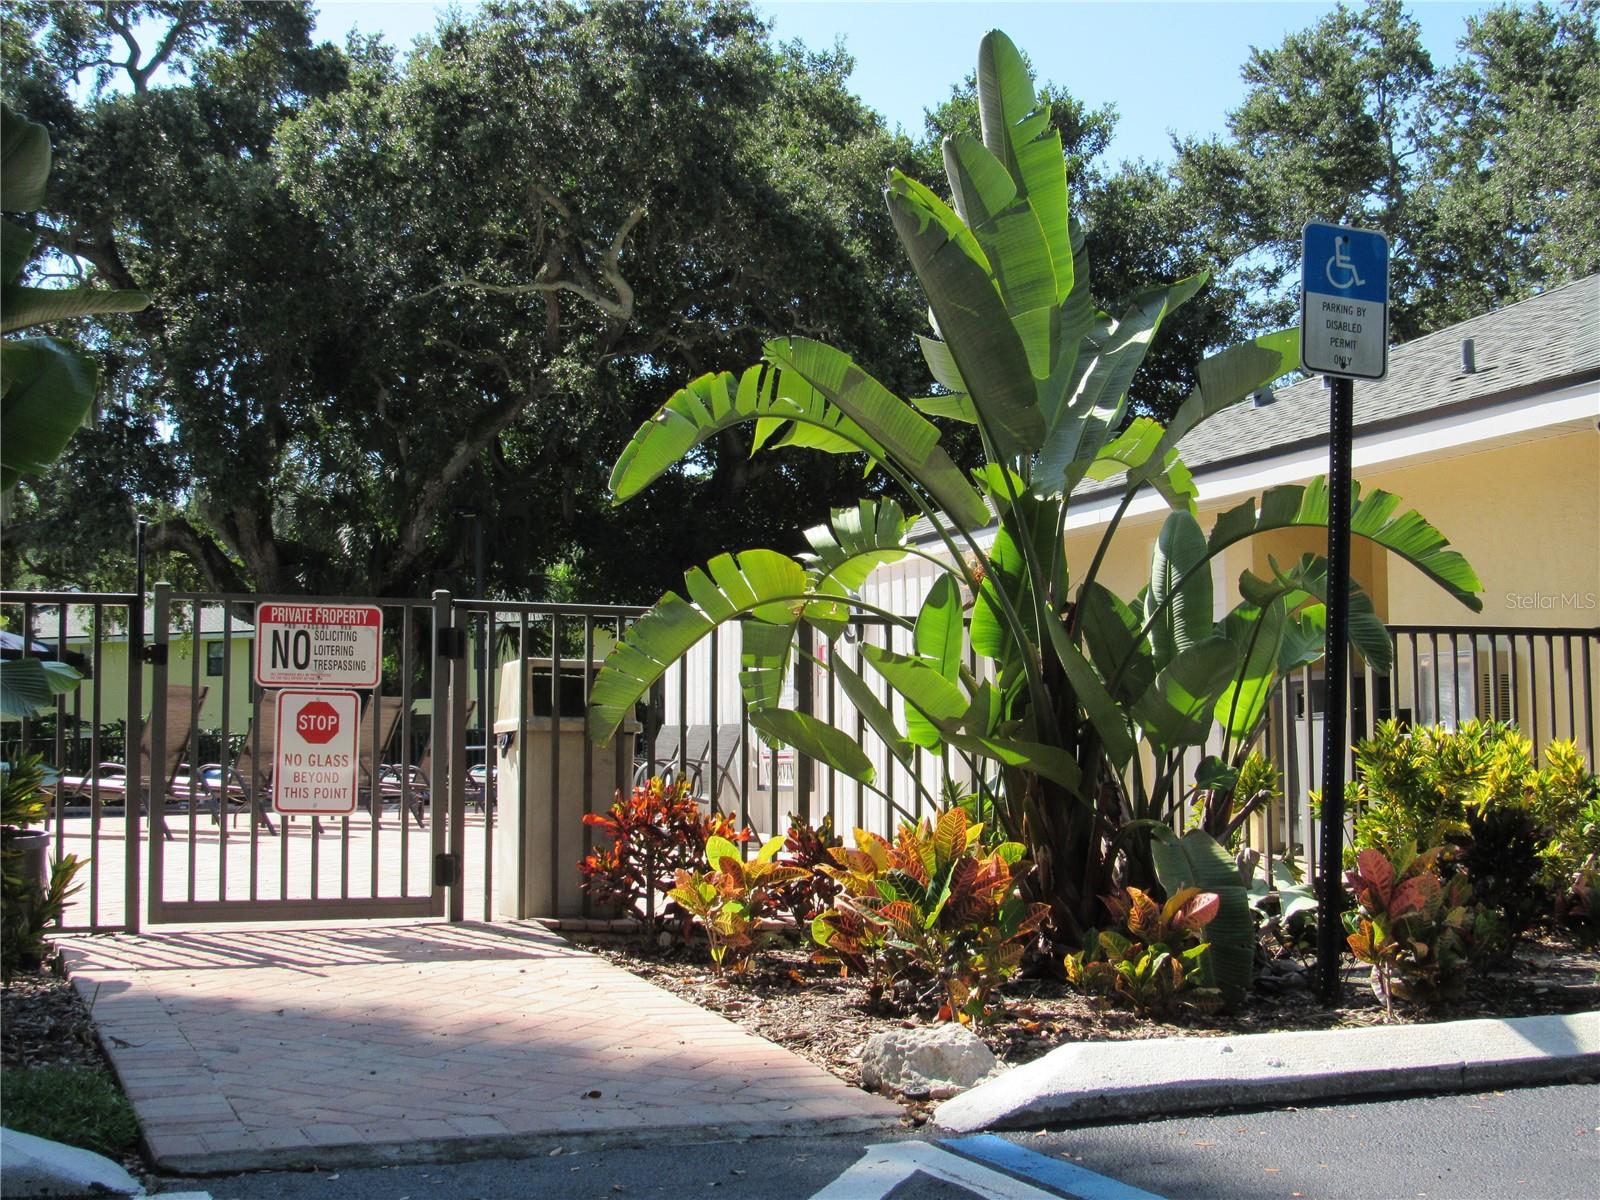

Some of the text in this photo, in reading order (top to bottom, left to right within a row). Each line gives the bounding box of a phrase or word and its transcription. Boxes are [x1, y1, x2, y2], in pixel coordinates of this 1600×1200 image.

[1322, 302, 1366, 317] PARKING BY
[1326, 320, 1362, 333] DISABLED
[1330, 337, 1357, 350] PERMIT
[271, 607, 368, 624] PRIVATE PROPERTY
[314, 630, 357, 642] SOLICITING
[271, 630, 311, 670] NO
[313, 645, 354, 656] LOITERING
[313, 659, 366, 671] TRESPASSING
[299, 715, 337, 731] STOP
[285, 753, 349, 767] NO GLASS
[293, 771, 339, 783] BEYOND
[284, 787, 347, 799] THIS POINT
